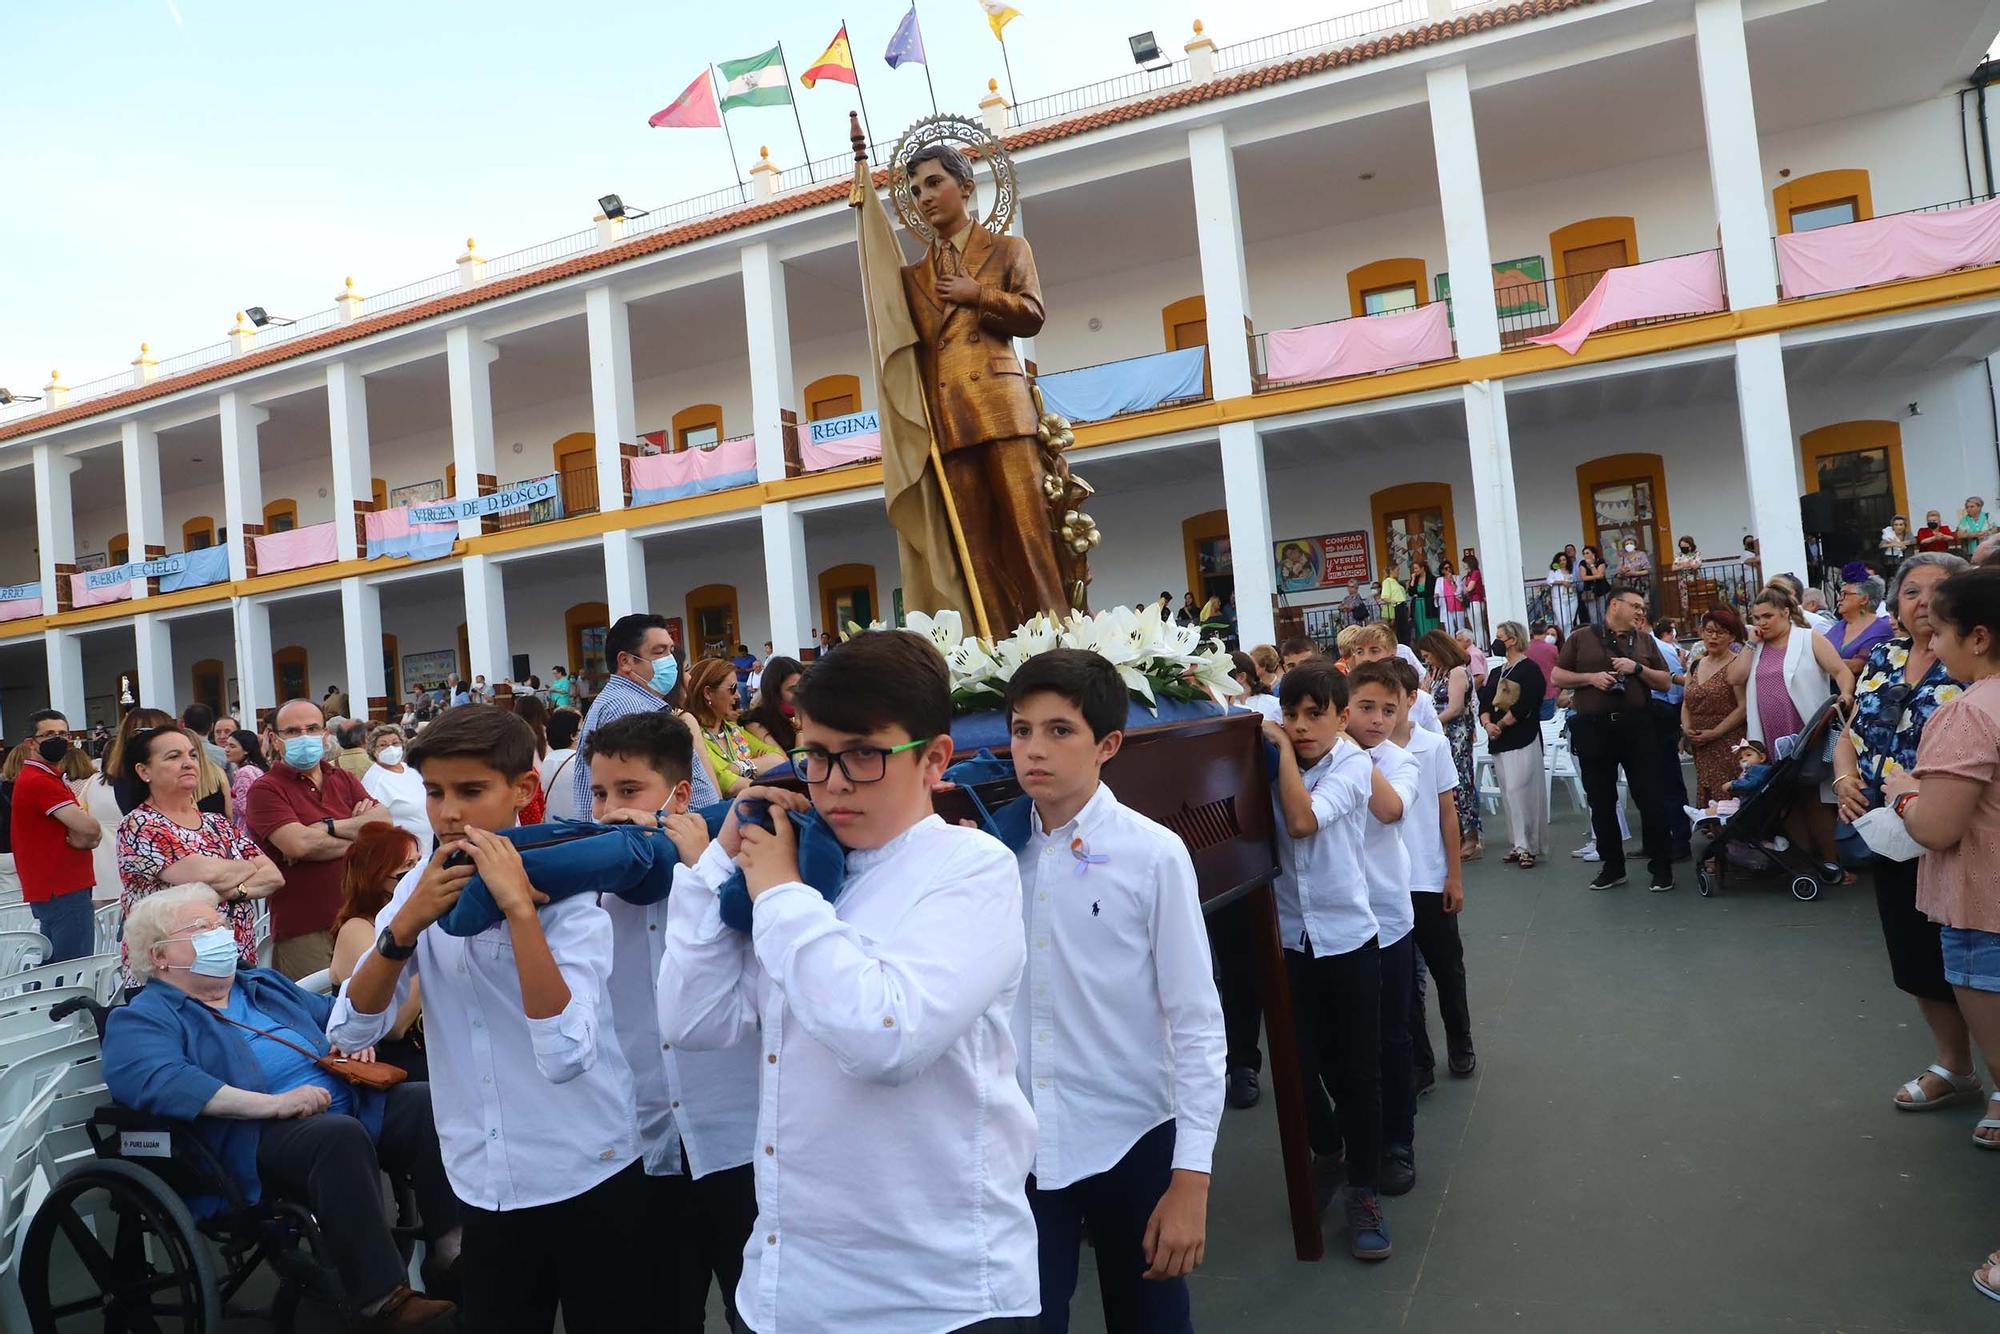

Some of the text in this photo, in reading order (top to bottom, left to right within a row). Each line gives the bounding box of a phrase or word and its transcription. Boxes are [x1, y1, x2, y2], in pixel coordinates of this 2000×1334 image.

[811, 415, 877, 441] REGINA
[414, 506, 455, 522] VIRGEN
[463, 501, 479, 516] DE
[1325, 534, 1362, 545] CONFIAD
[143, 560, 179, 575] CIELO
[1328, 569, 1367, 579] MILAGROS
